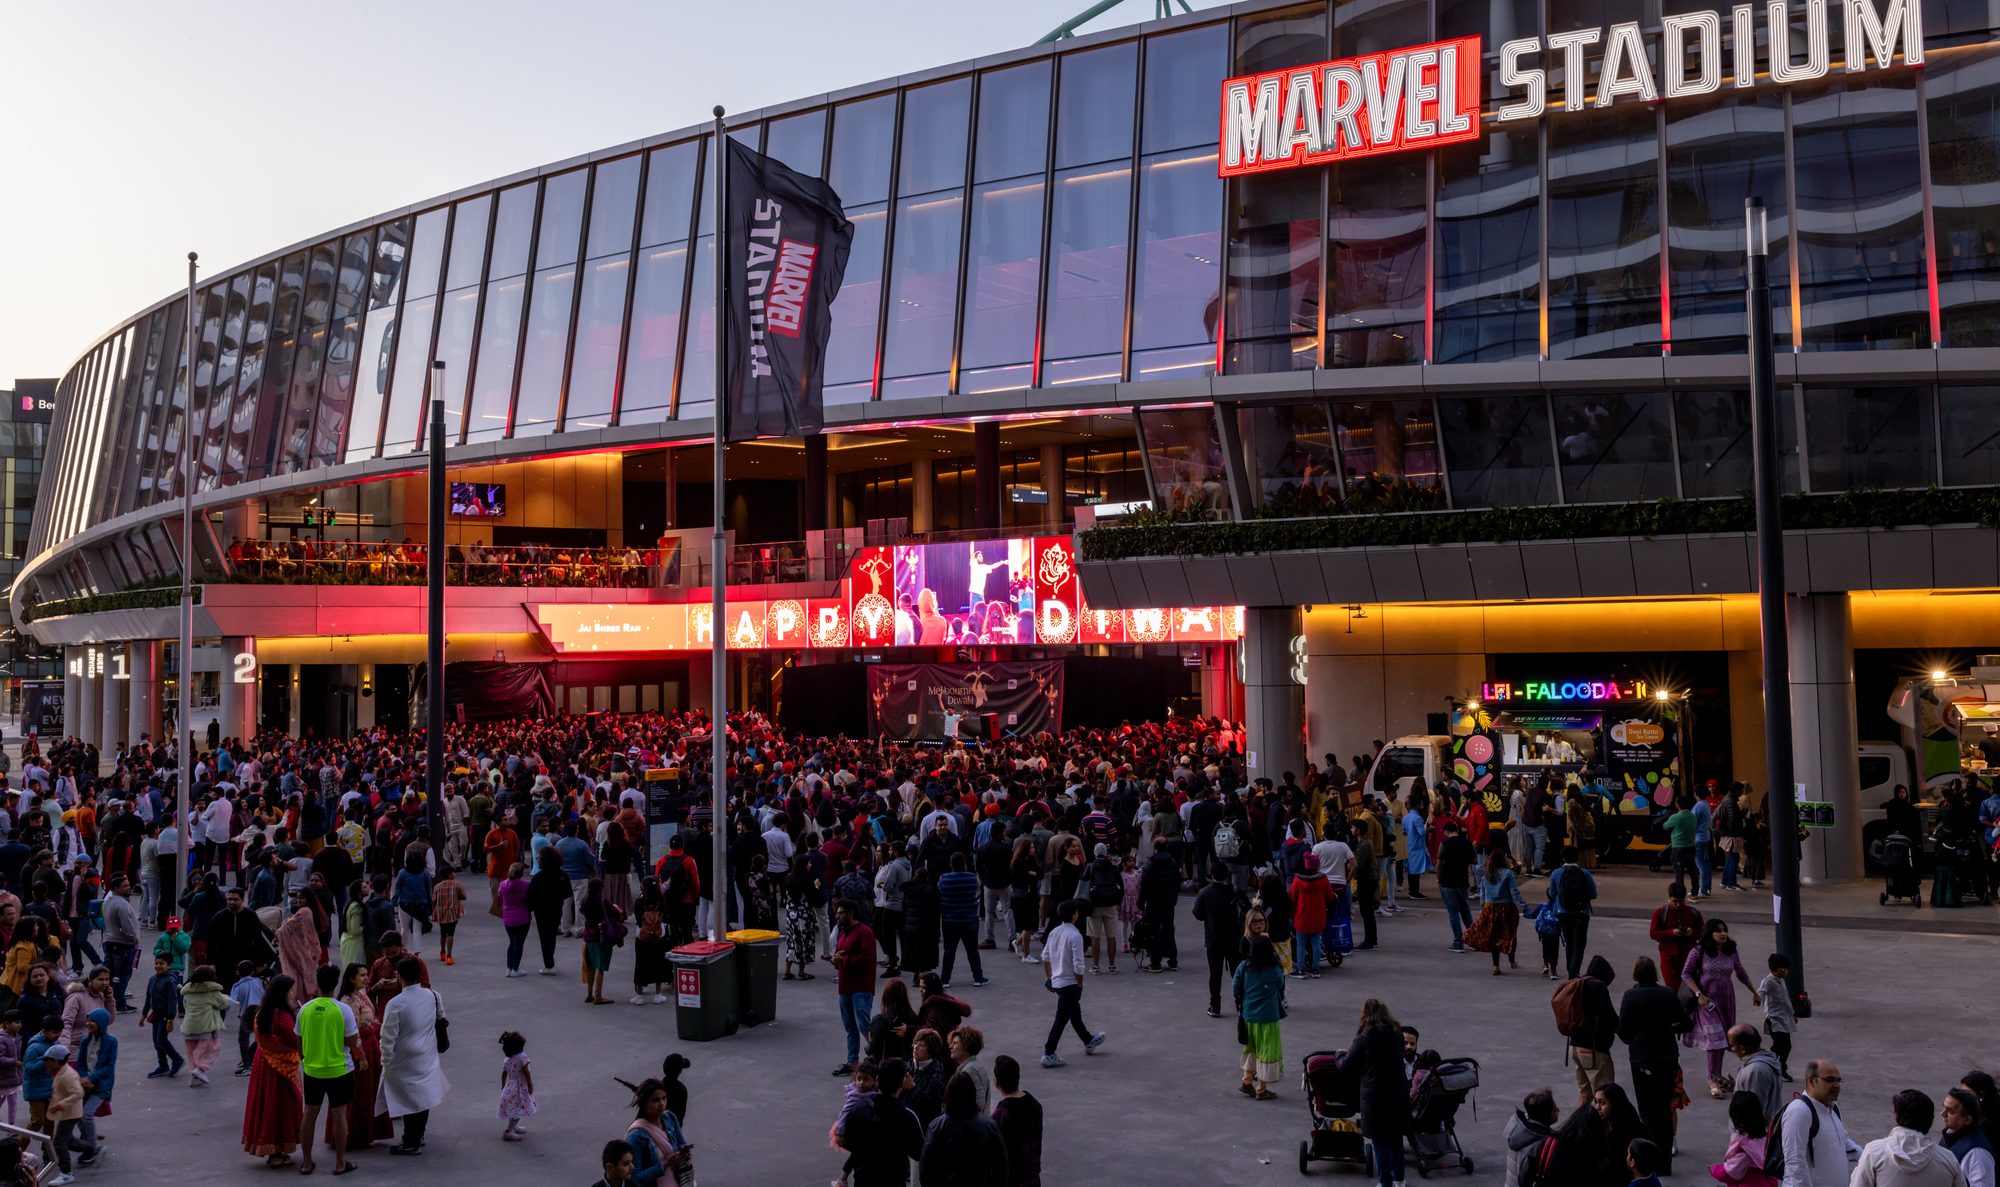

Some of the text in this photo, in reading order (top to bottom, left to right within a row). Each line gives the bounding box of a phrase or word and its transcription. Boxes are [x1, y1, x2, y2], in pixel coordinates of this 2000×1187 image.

[1225, 0, 1925, 168] MARVEL STADIUM
[87, 648, 96, 679] SERVICES
[96, 652, 104, 674] GUEST
[112, 654, 130, 680] 1
[233, 652, 256, 684] 2
[928, 685, 974, 696] Melbourne
[947, 696, 974, 705] Diwali
[1526, 683, 1621, 700] FALOODA
